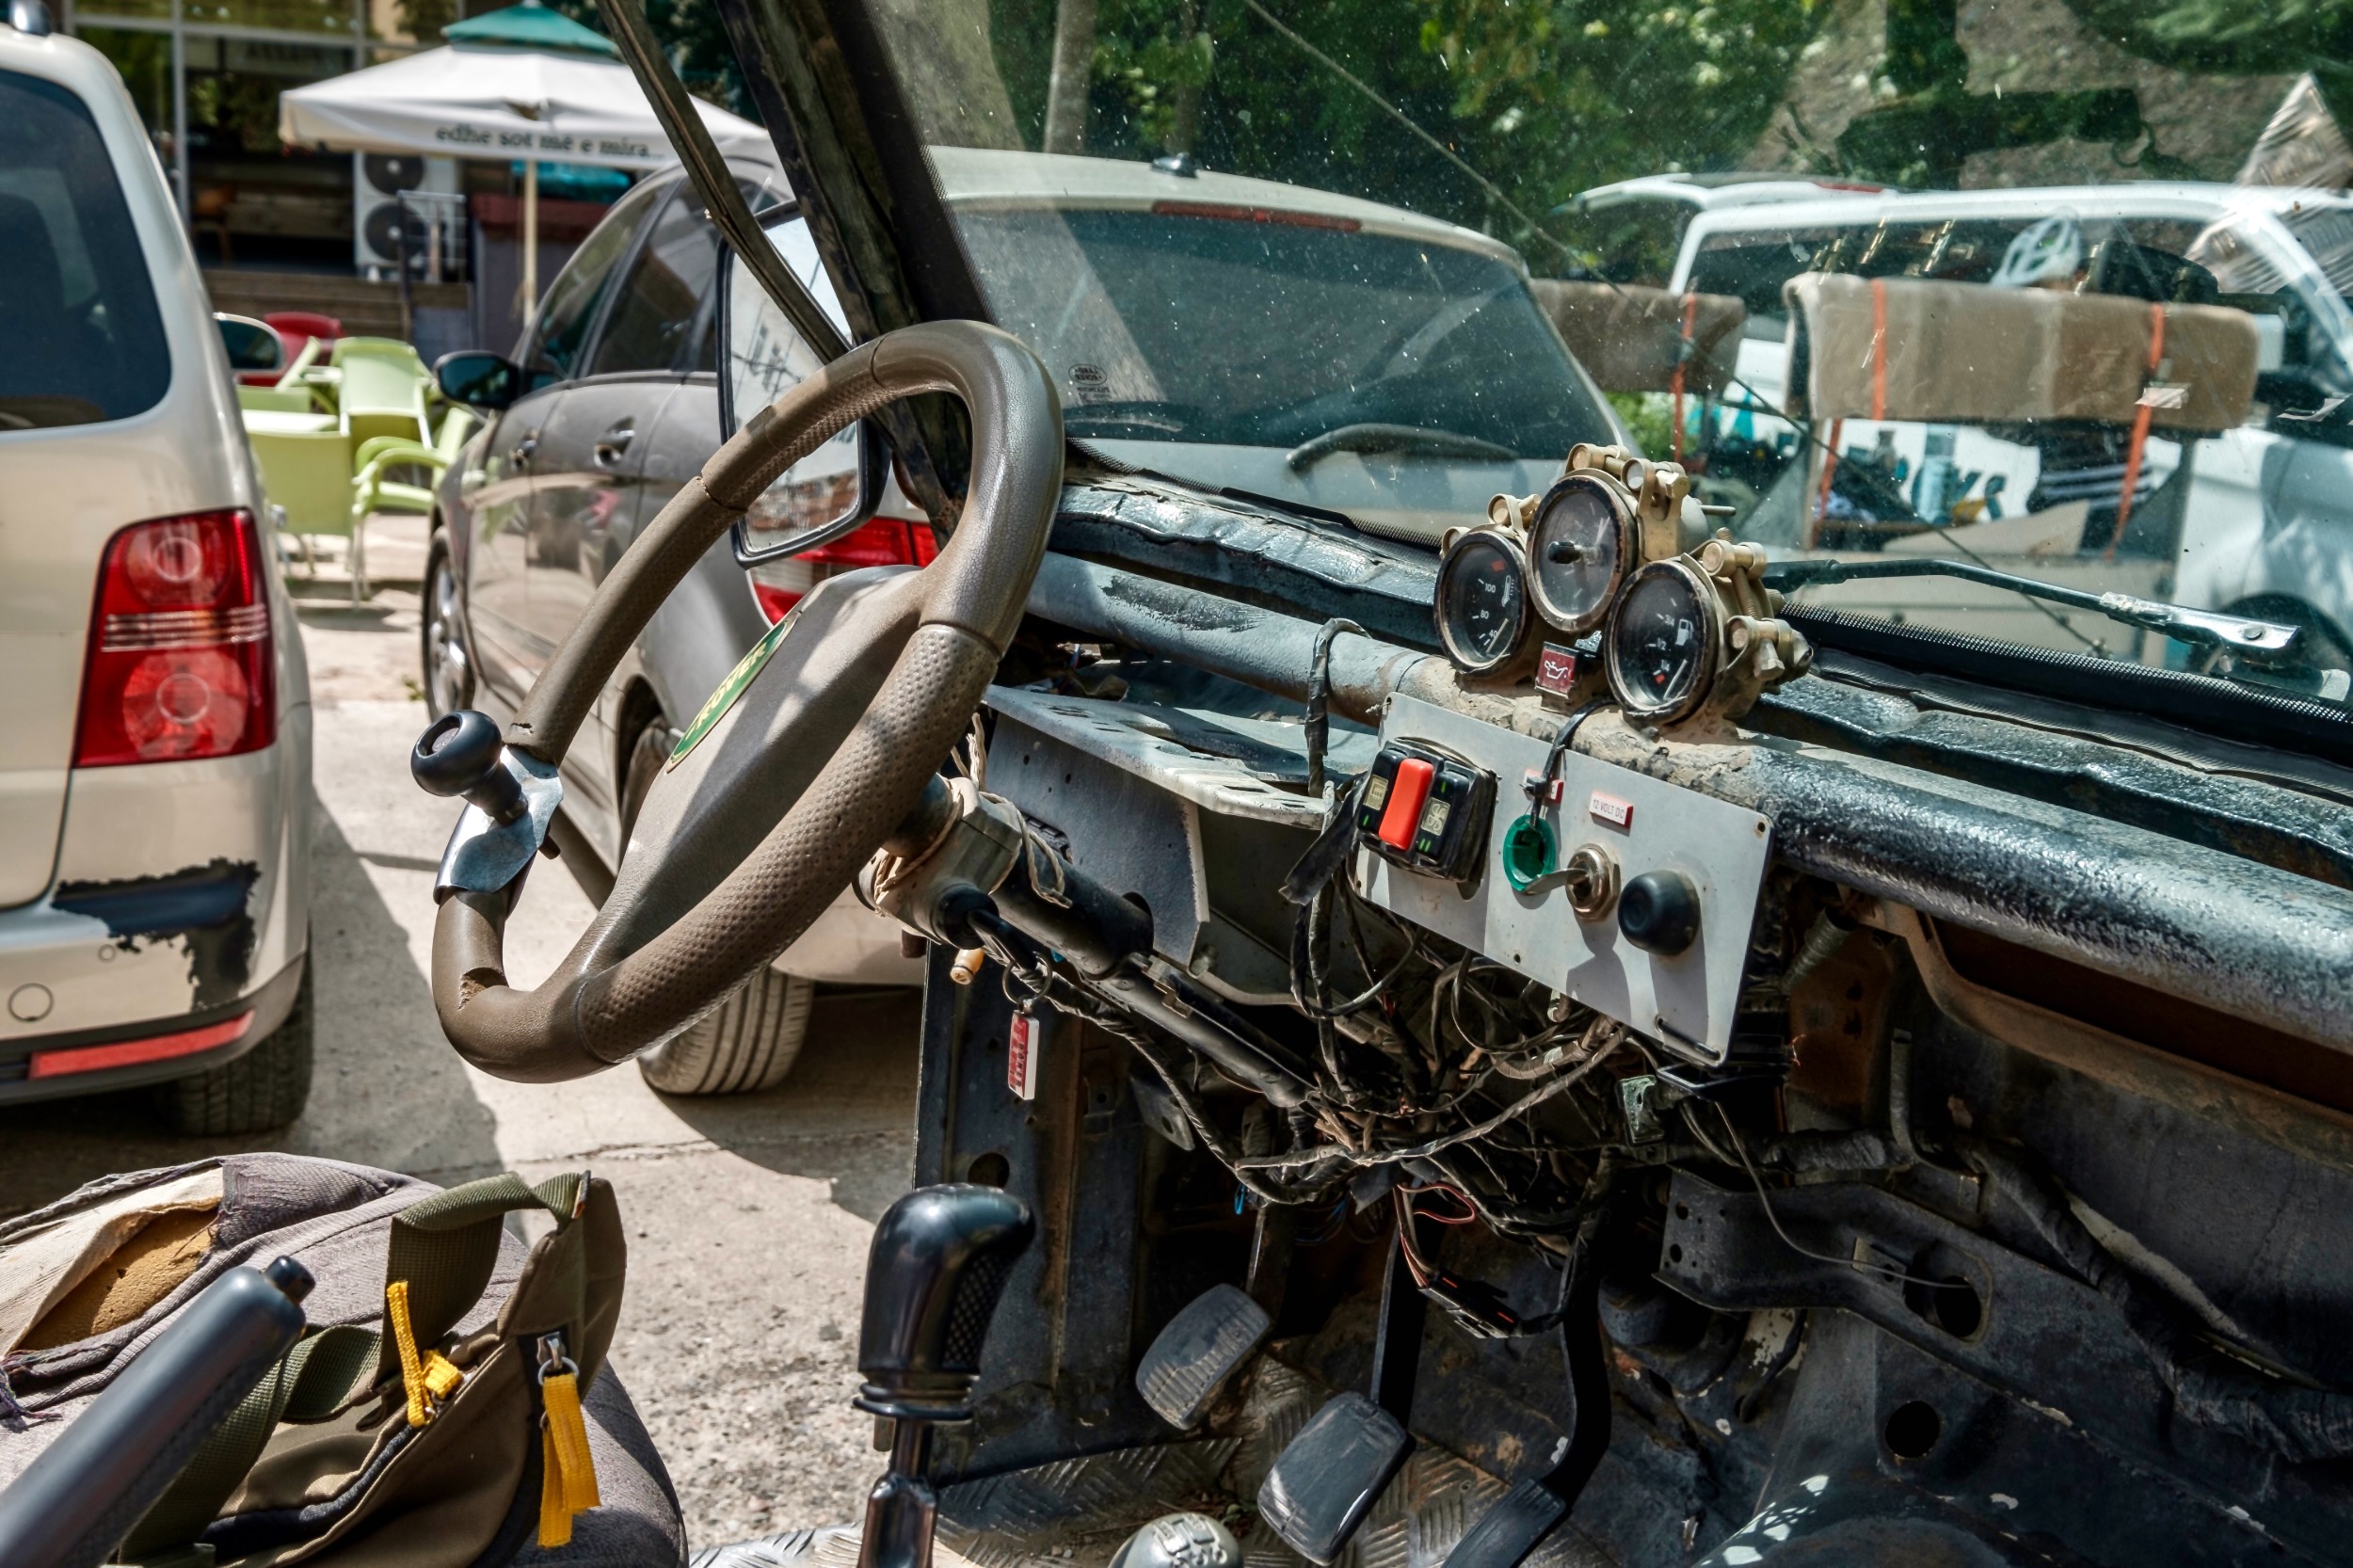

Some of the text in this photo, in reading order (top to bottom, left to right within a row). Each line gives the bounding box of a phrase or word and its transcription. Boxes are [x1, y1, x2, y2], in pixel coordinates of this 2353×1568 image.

[436, 123, 492, 144] edhe
[500, 131, 533, 147] sot
[581, 138, 594, 152] e
[1484, 583, 1497, 594] 100
[1480, 609, 1490, 619] 80
[1488, 629, 1498, 638] 40
[1593, 798, 1625, 819] 12 VOLT DC
